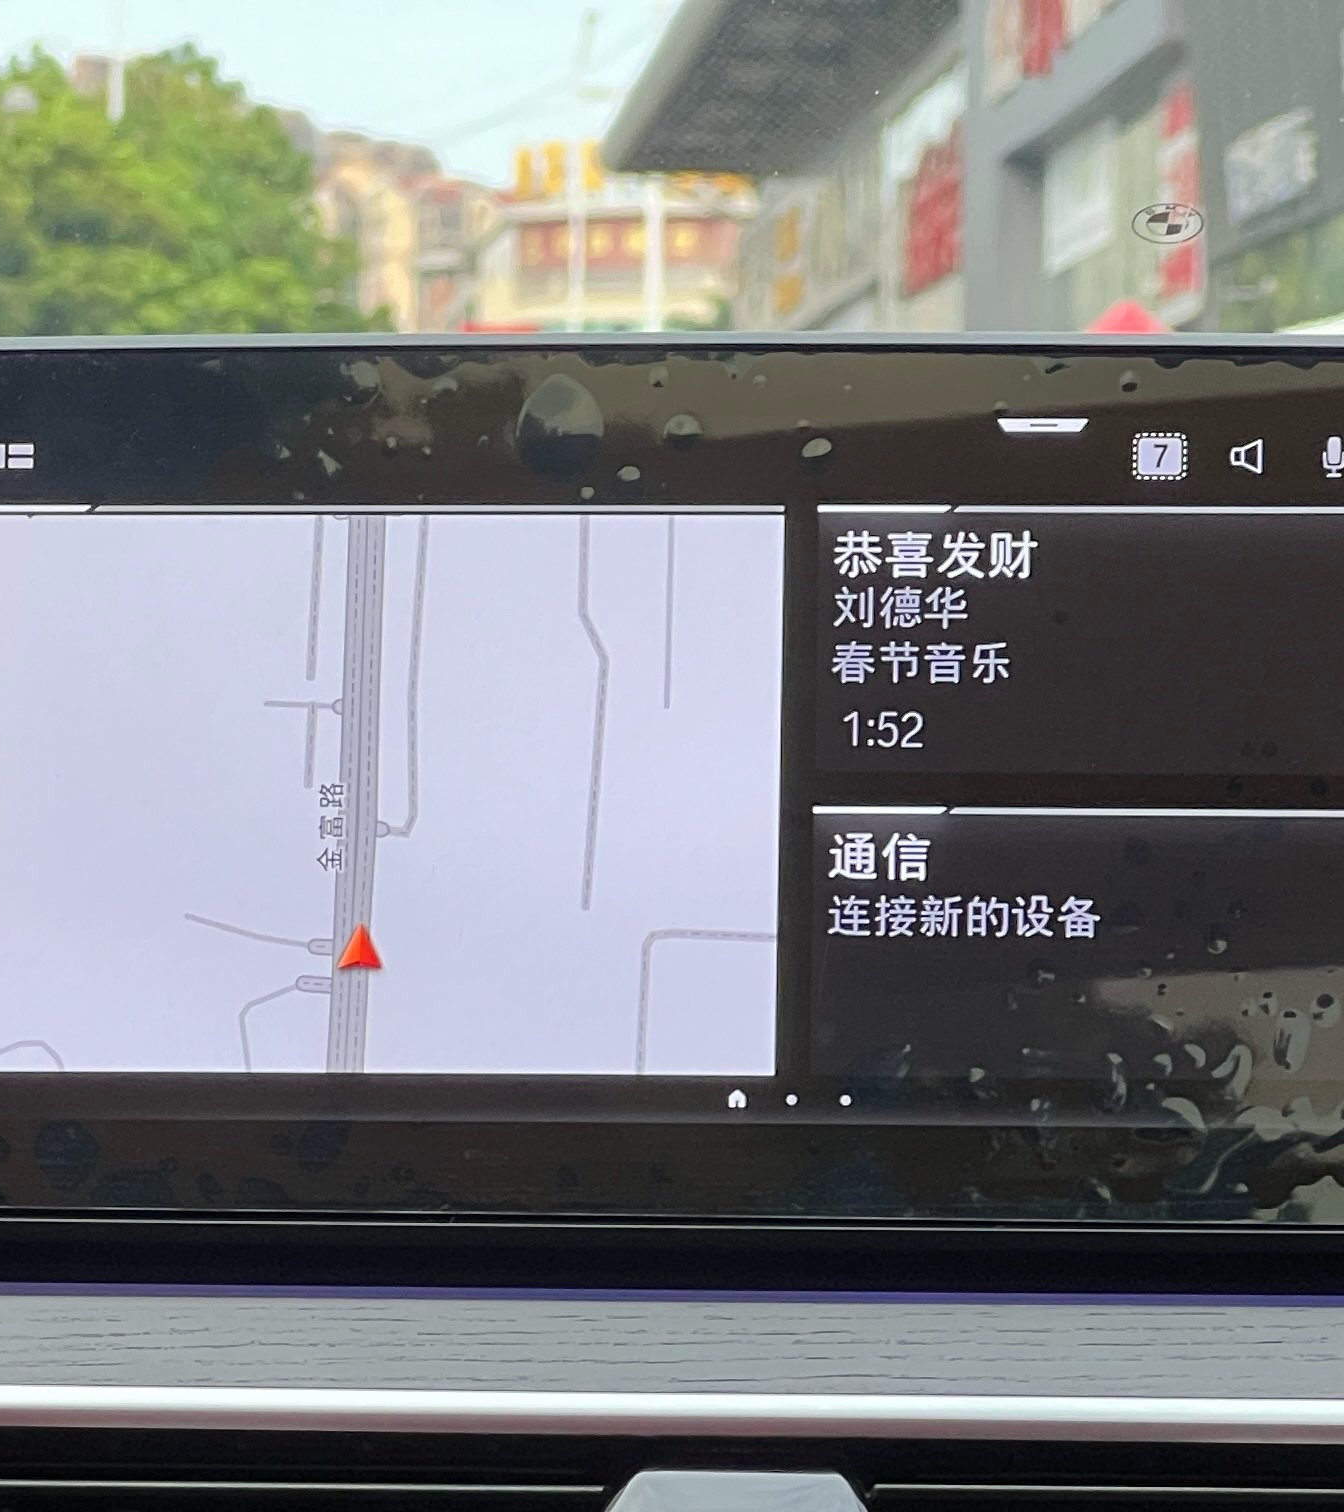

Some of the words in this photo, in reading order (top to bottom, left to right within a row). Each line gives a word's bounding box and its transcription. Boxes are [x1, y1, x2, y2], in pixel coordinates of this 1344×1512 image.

[1153, 444, 1168, 468] 7
[833, 530, 1039, 580] 恭喜发财
[833, 585, 969, 631] 刘德华
[831, 640, 1011, 685] 春节音乐
[843, 711, 925, 749] 1:52
[316, 783, 344, 872] 金富路
[828, 832, 931, 882] 通信
[827, 894, 1102, 941] 连接新的设备
